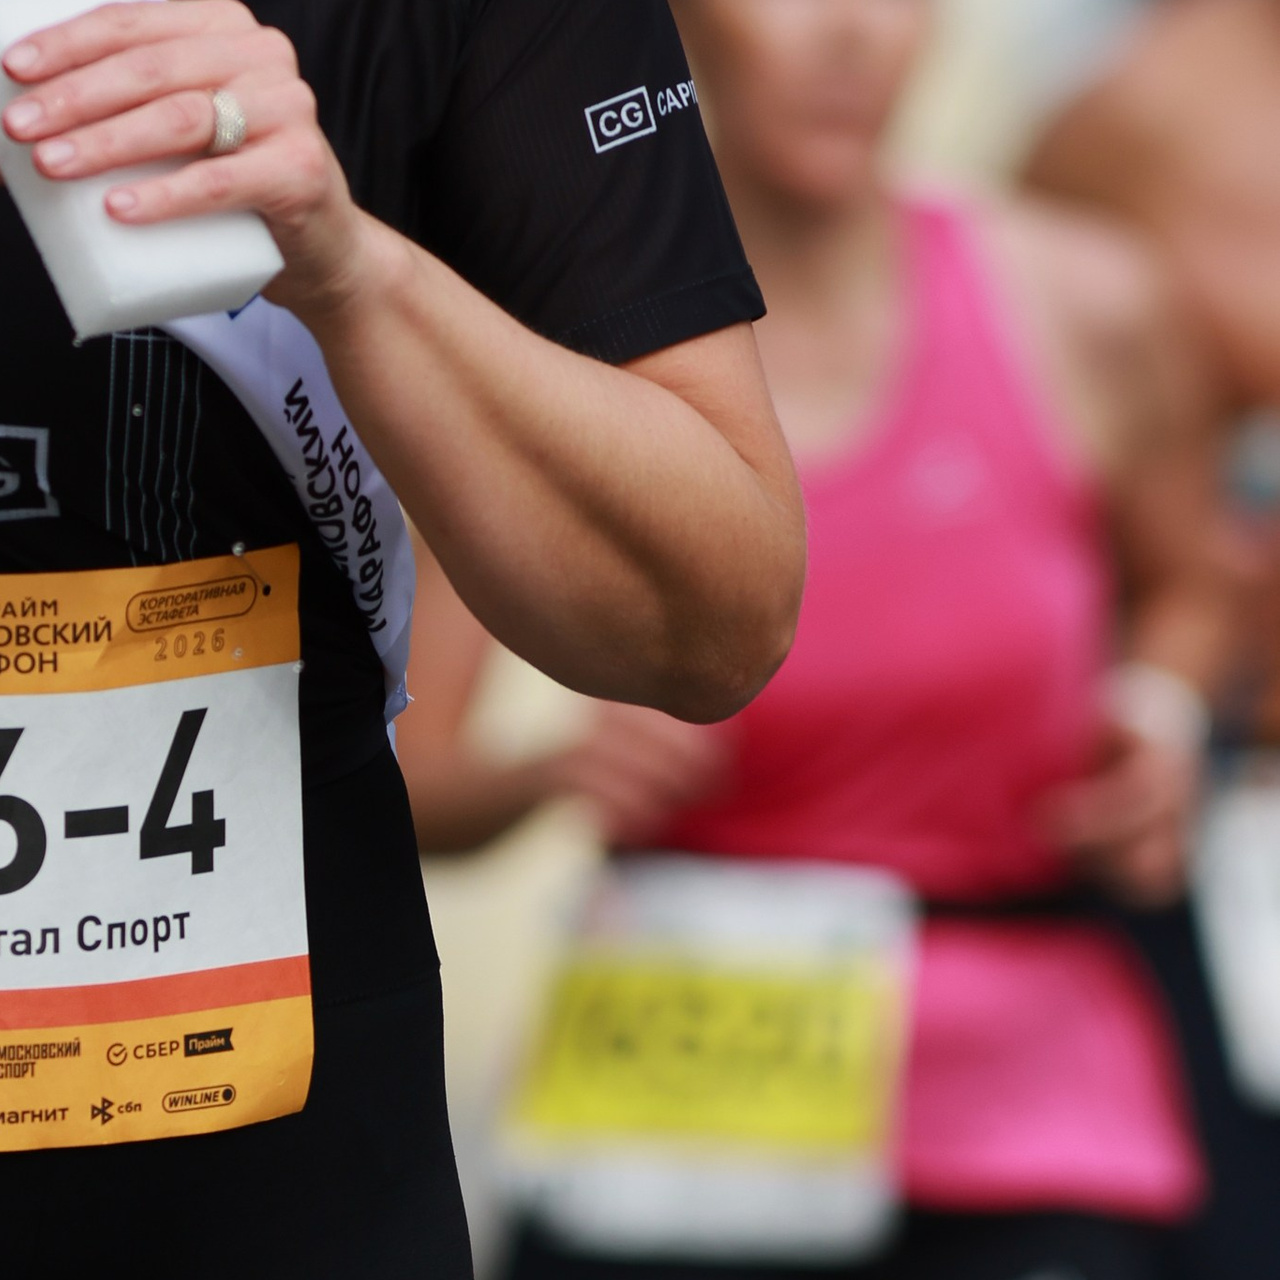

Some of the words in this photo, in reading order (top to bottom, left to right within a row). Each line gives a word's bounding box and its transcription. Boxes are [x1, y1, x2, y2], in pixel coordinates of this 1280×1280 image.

[599, 101, 644, 138] CG
[138, 581, 247, 611] КОРПОРАТИВНАЯ
[136, 605, 199, 626] ЭСТАФЕТА
[153, 627, 226, 662] 2026
[77, 911, 191, 953] Спорт
[133, 1040, 180, 1060] СБЕР
[188, 1035, 226, 1053] Прайм
[168, 1090, 220, 1109] WINLINE
